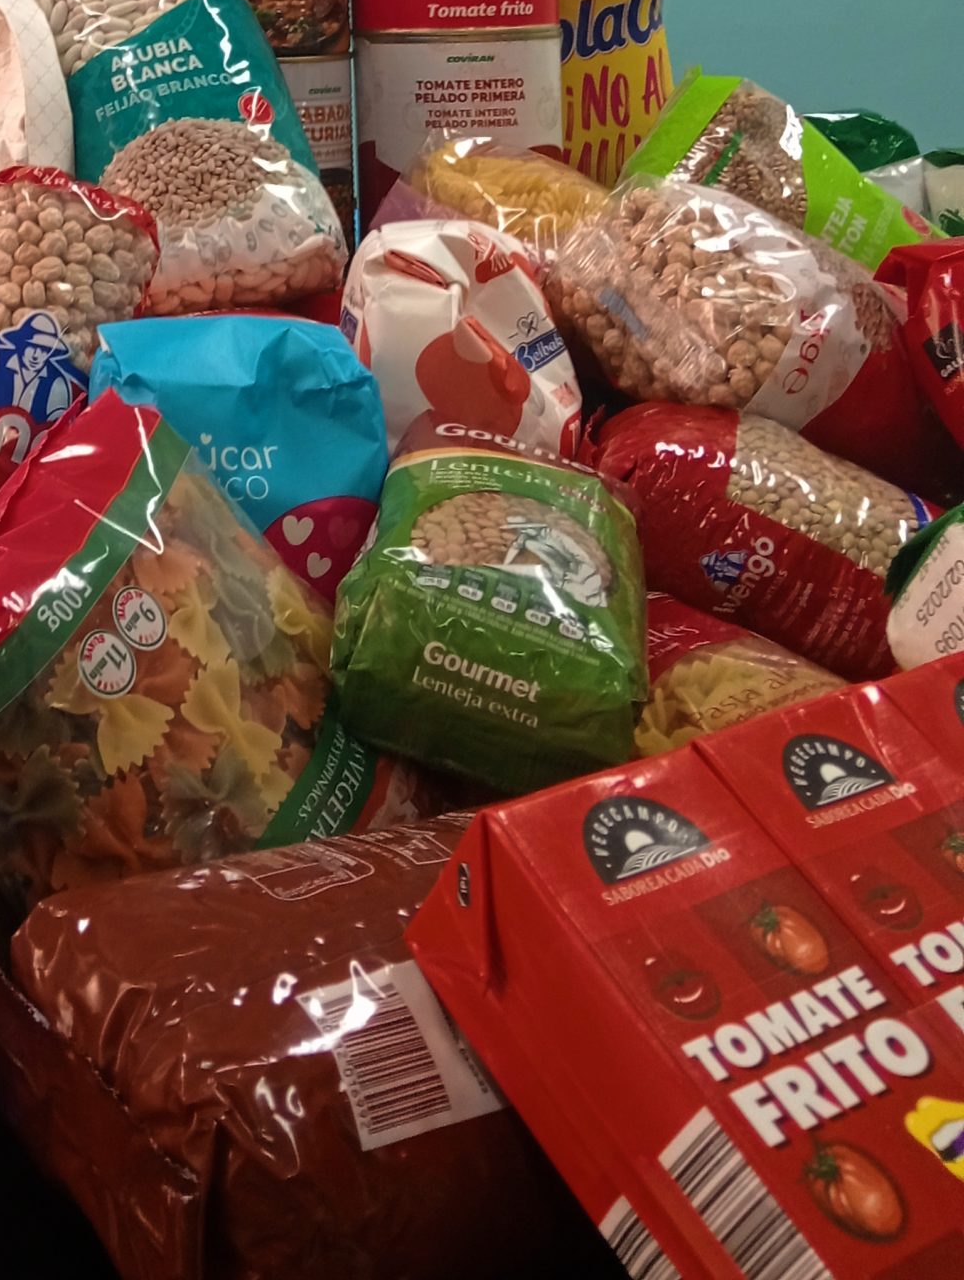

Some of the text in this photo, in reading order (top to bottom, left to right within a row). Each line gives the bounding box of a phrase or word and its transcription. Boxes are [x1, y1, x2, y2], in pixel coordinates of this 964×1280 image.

[427, 0, 534, 19] Tomate frito
[110, 54, 204, 93] BLANCA
[157, 73, 232, 99] BRANCO
[416, 77, 524, 91] TOMATE ENTERO
[302, 103, 350, 124] ABAD
[415, 90, 526, 104] PELADO PRIMERA
[427, 107, 516, 118] TOMATE INTEIRO
[425, 118, 519, 129] PELADO PRIMEIRA
[516, 333, 565, 371] Belbak
[196, 433, 279, 471] úcar
[125, 599, 156, 632] 9 min
[89, 643, 128, 680] 11 min
[423, 640, 541, 704] Gourmet
[411, 665, 539, 729] Lenteja extra
[791, 741, 867, 786] VEGECAMPO
[305, 760, 365, 842] VEGETA
[592, 802, 681, 857] VEGECAMPO
[682, 965, 886, 1082] TOMATE
[729, 1018, 930, 1148] FRITO
